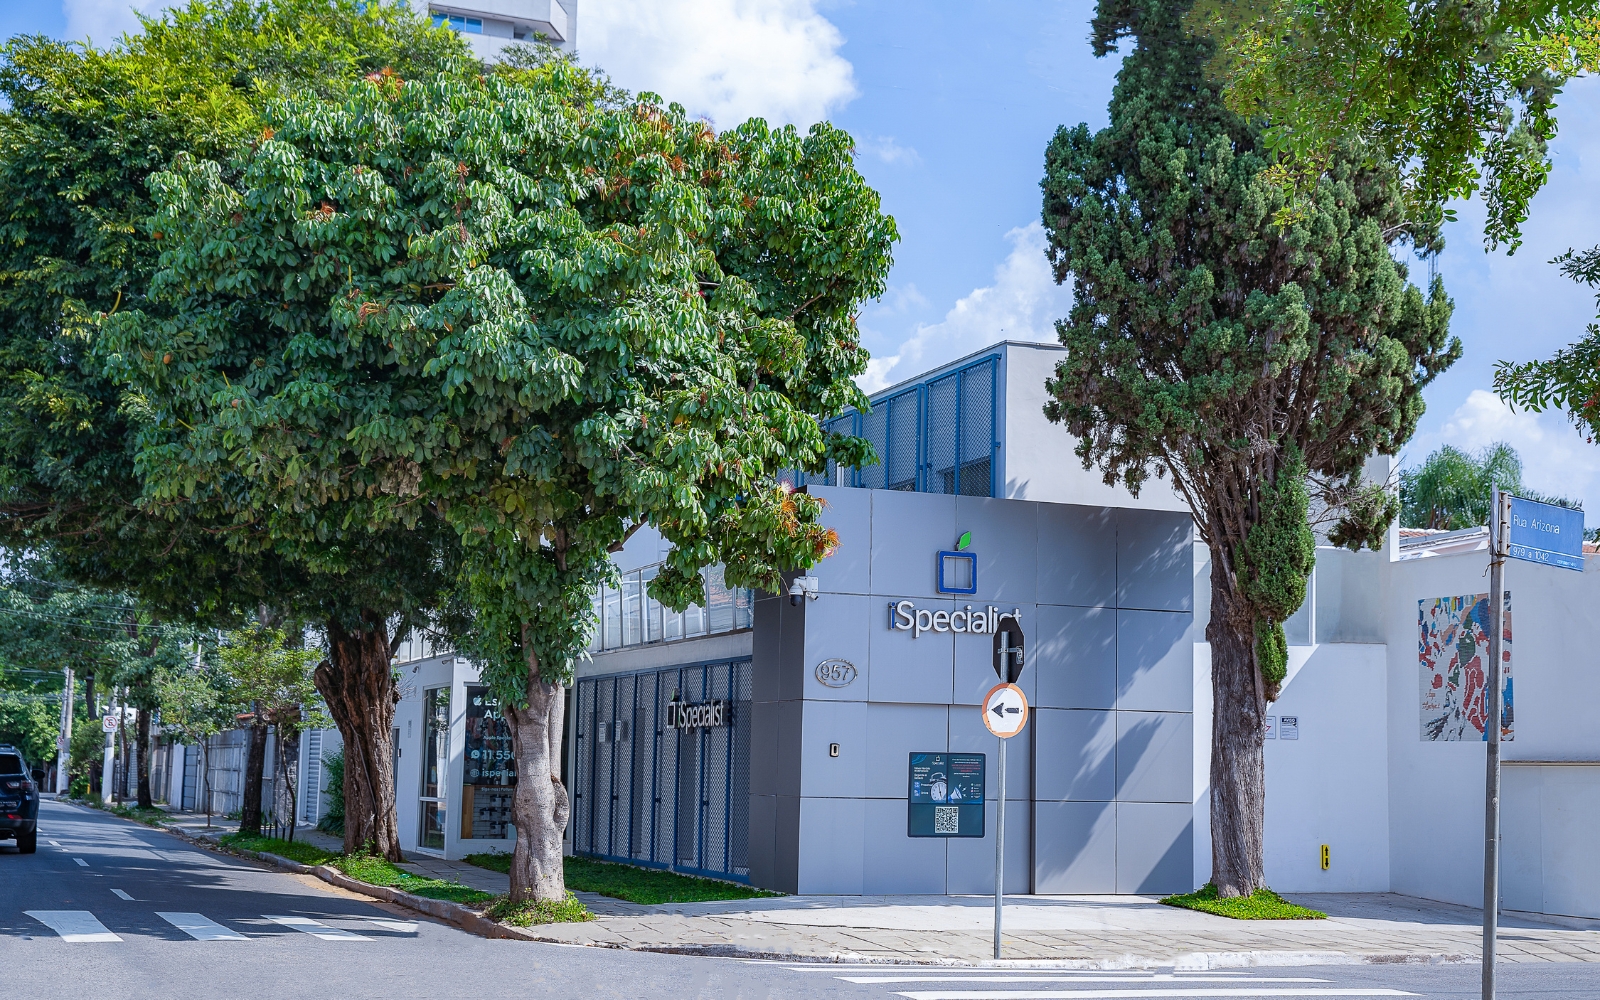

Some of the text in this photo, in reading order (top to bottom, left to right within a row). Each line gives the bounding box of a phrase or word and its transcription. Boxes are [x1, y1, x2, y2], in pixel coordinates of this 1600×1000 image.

[1513, 514, 1560, 535] Rua Arizona
[1512, 546, 1550, 562] 979 a 1042
[888, 600, 1022, 639] iSpecialit
[820, 664, 851, 681] 957
[678, 699, 724, 734] iSpecialist
[482, 750, 492, 760] 11
